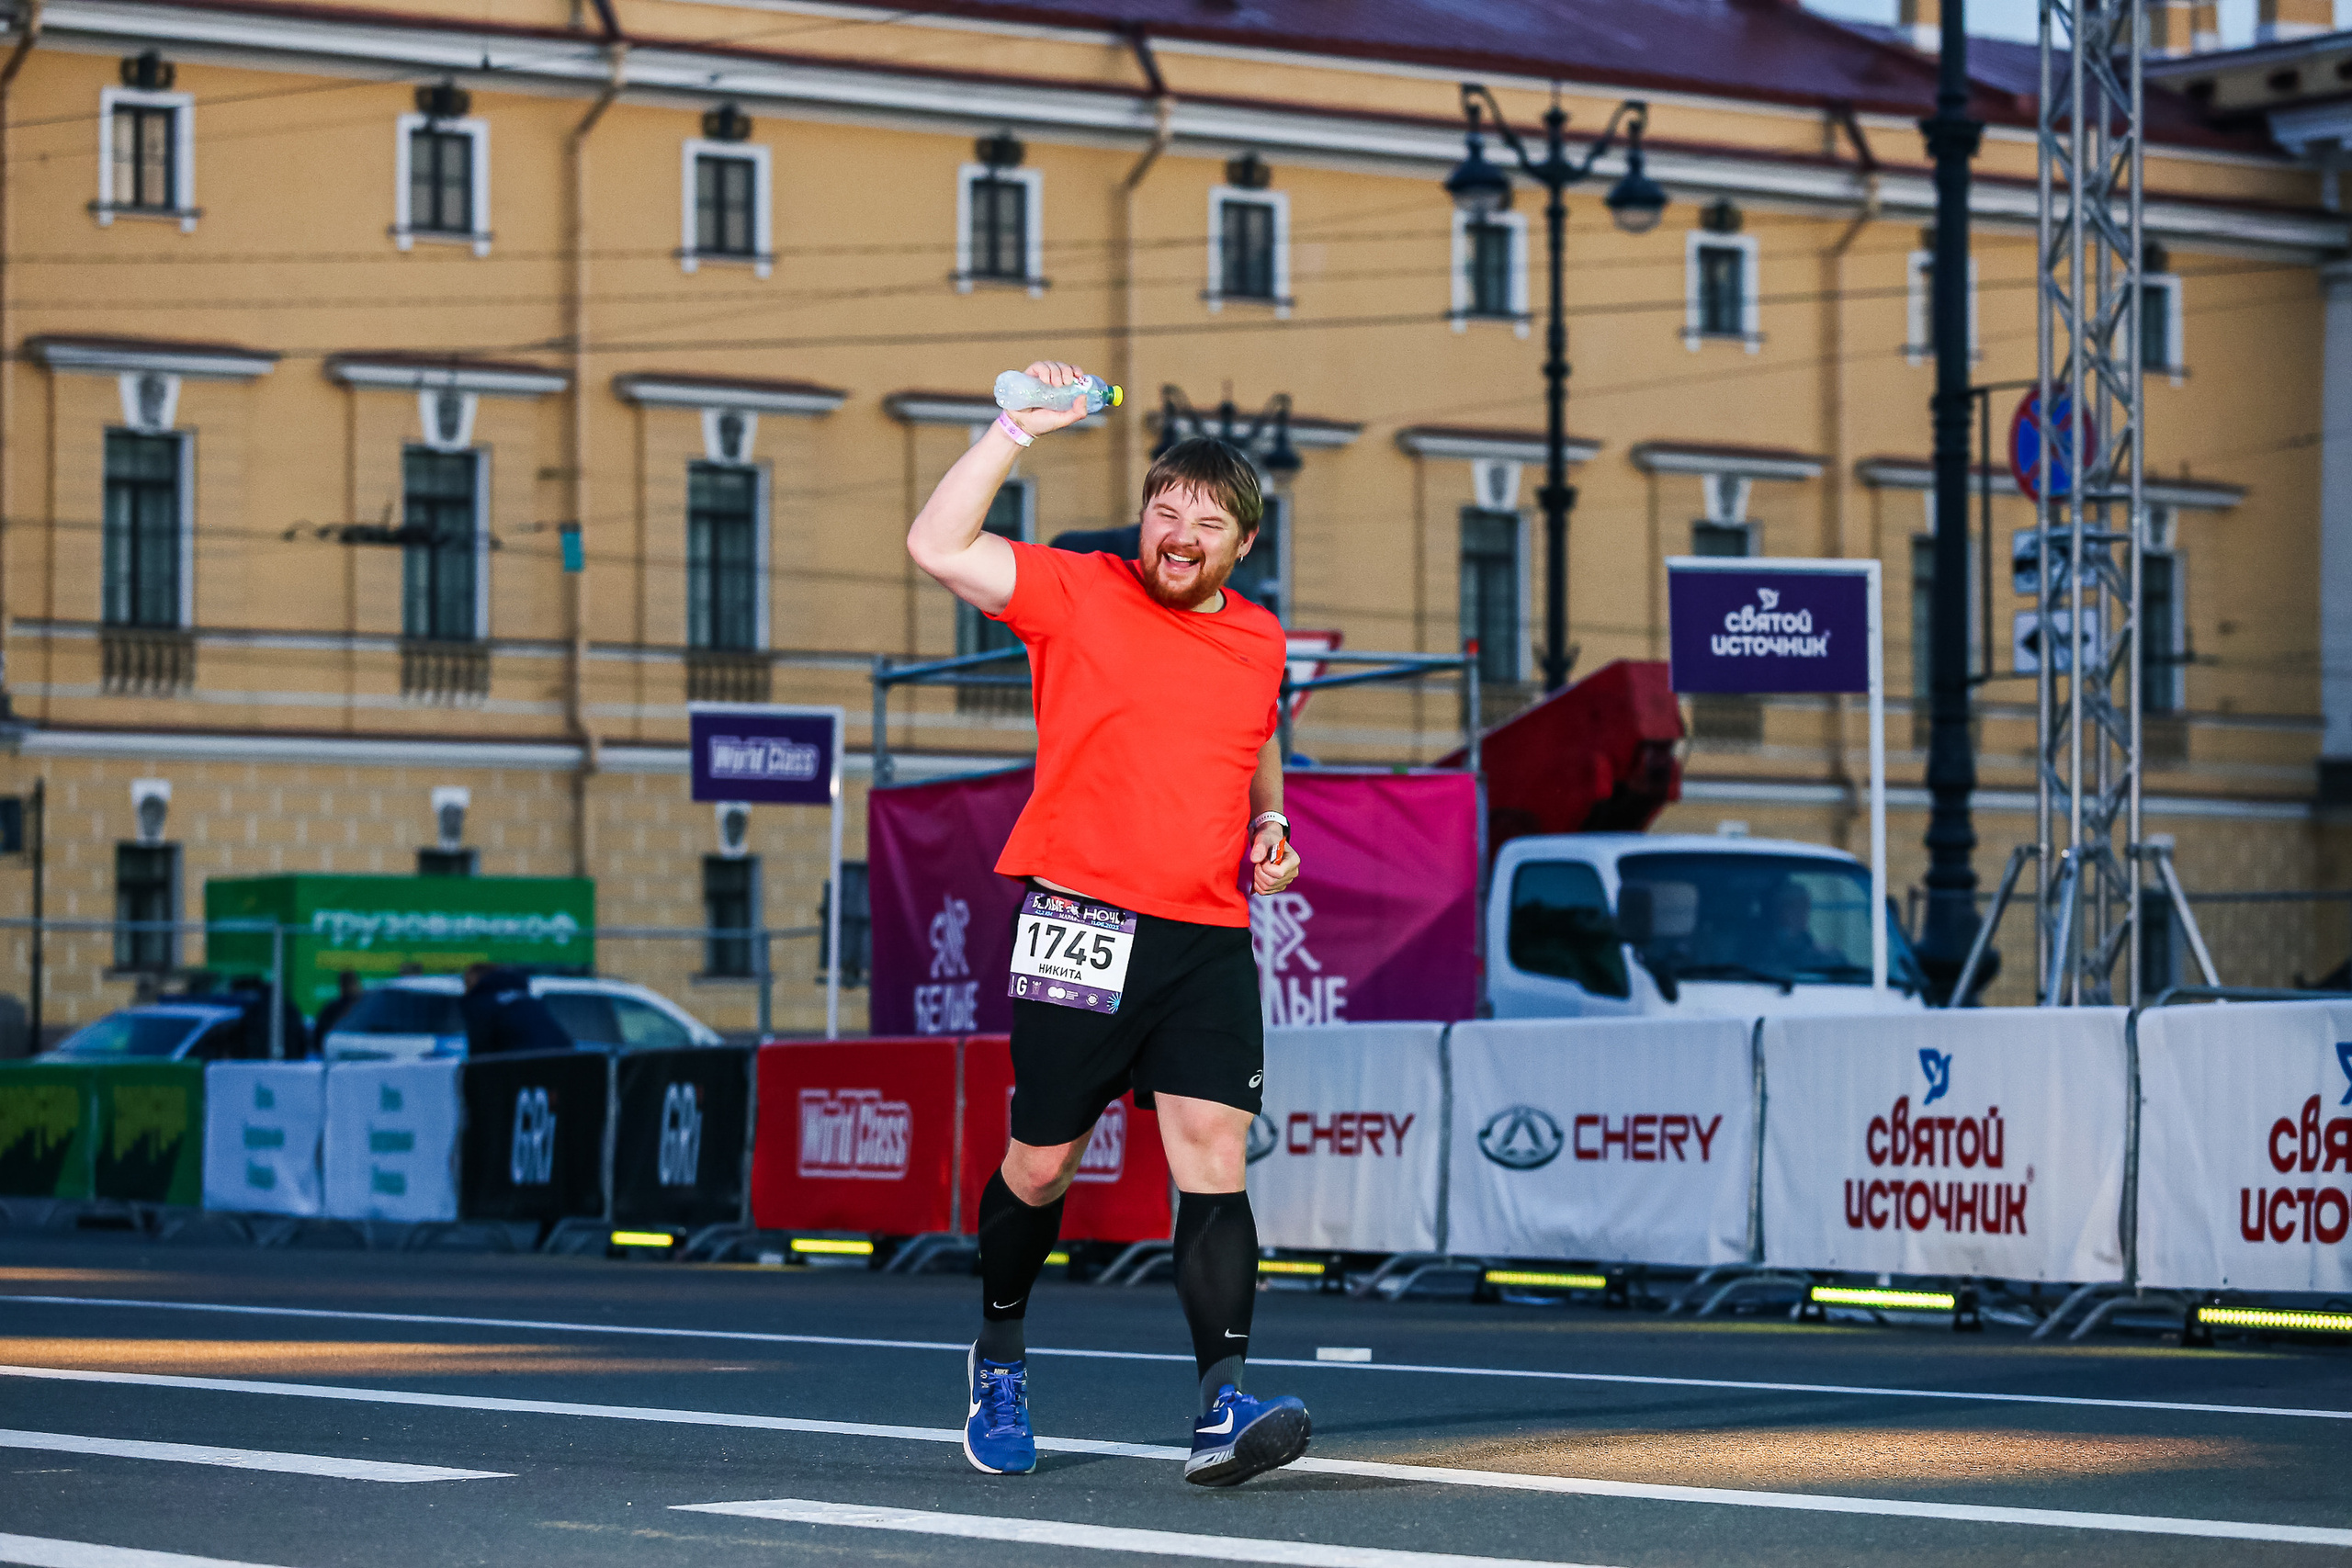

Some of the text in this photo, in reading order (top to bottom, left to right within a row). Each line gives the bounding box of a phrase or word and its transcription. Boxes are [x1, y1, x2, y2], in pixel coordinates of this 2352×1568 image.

[1027, 921, 1115, 970] 1745
[1016, 976, 1028, 997] G
[1038, 963, 1082, 980] НИКИТА
[1287, 1111, 1416, 1156] CHERY
[1574, 1113, 1723, 1162] CHERY
